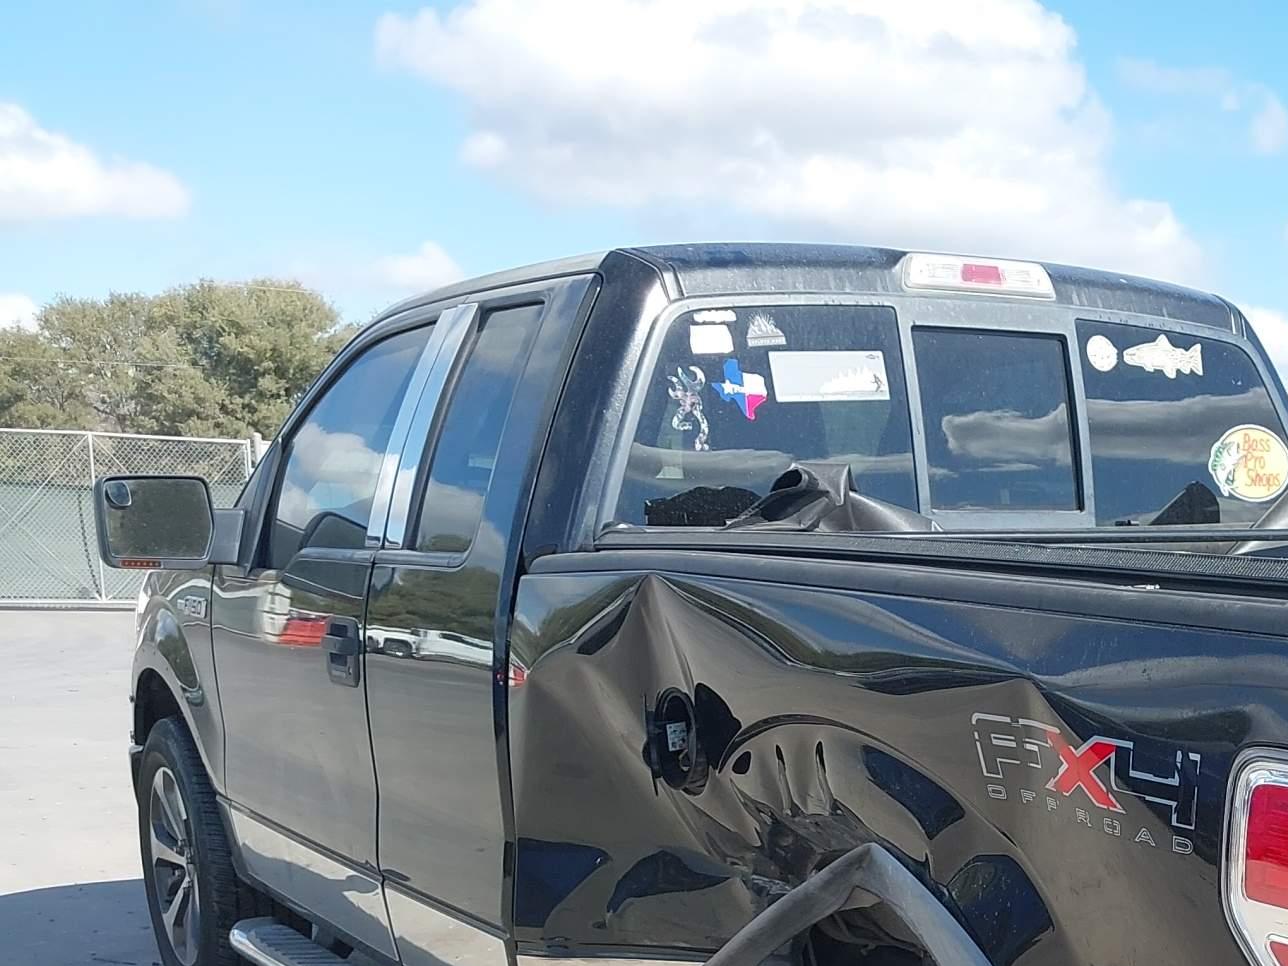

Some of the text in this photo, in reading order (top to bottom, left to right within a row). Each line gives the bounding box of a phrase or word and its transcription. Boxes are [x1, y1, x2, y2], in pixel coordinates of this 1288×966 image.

[1242, 433, 1271, 452] Bass
[1242, 451, 1266, 469] Pro
[1244, 469, 1281, 491] Shops
[971, 712, 1201, 829] FX4
